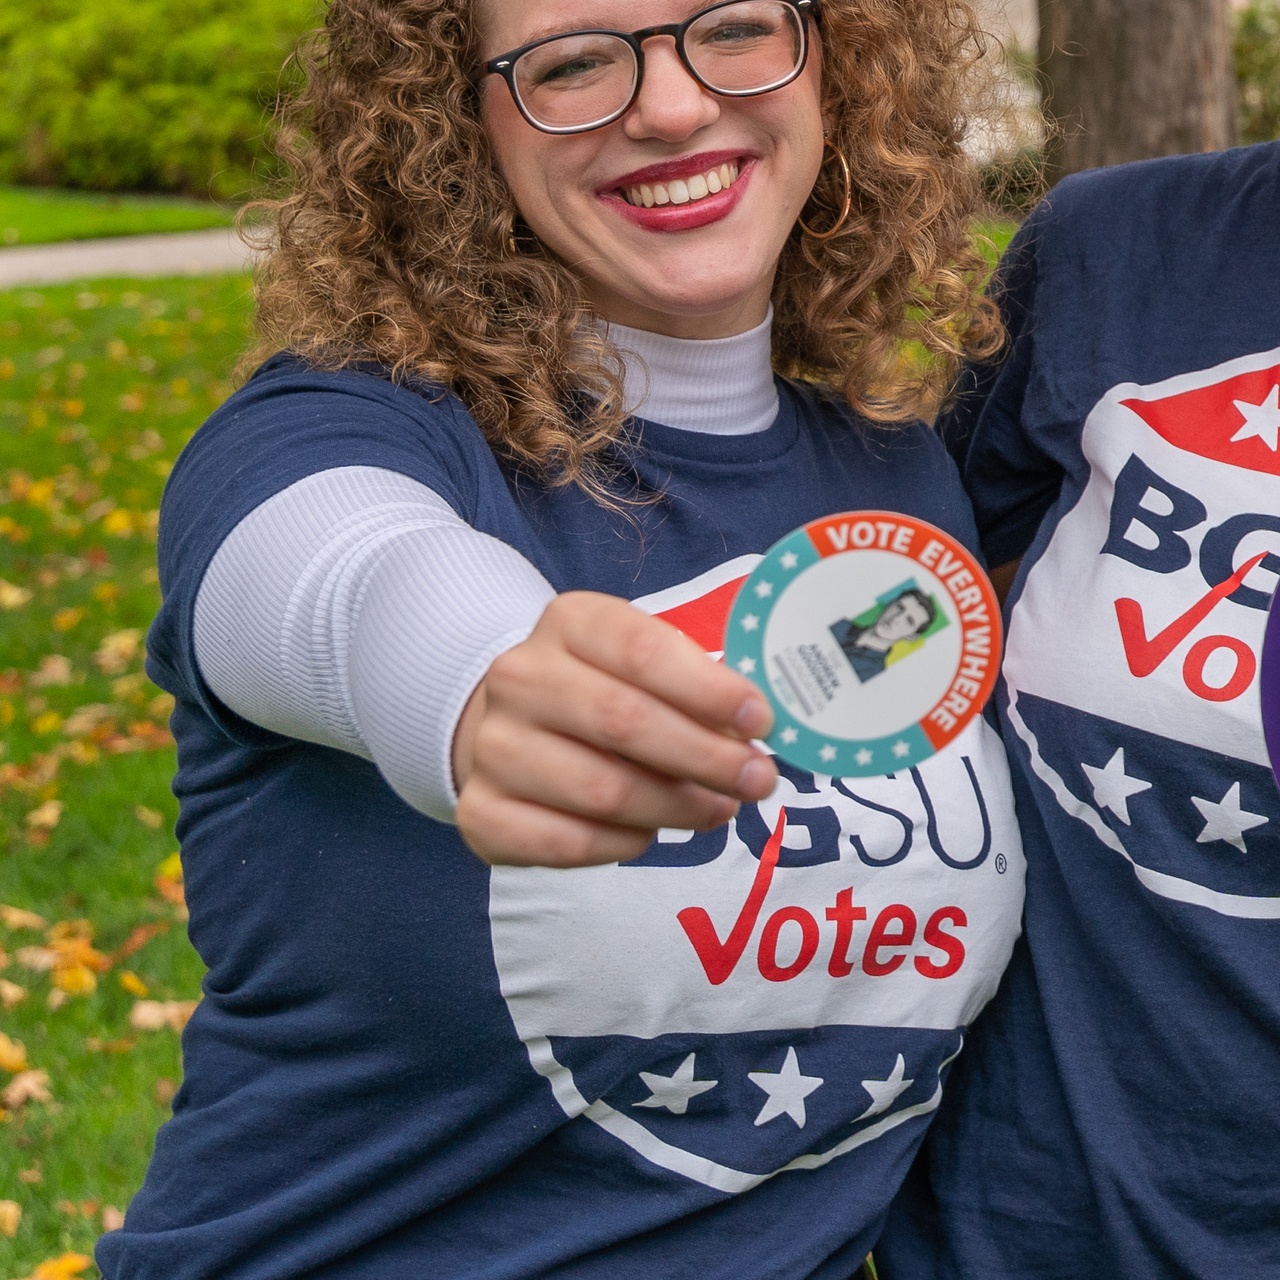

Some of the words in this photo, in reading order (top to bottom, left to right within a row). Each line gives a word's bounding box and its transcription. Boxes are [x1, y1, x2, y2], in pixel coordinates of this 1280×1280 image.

[826, 521, 915, 553] VOTE
[918, 539, 992, 734] EVERYWHERE
[677, 805, 968, 986] Votes
